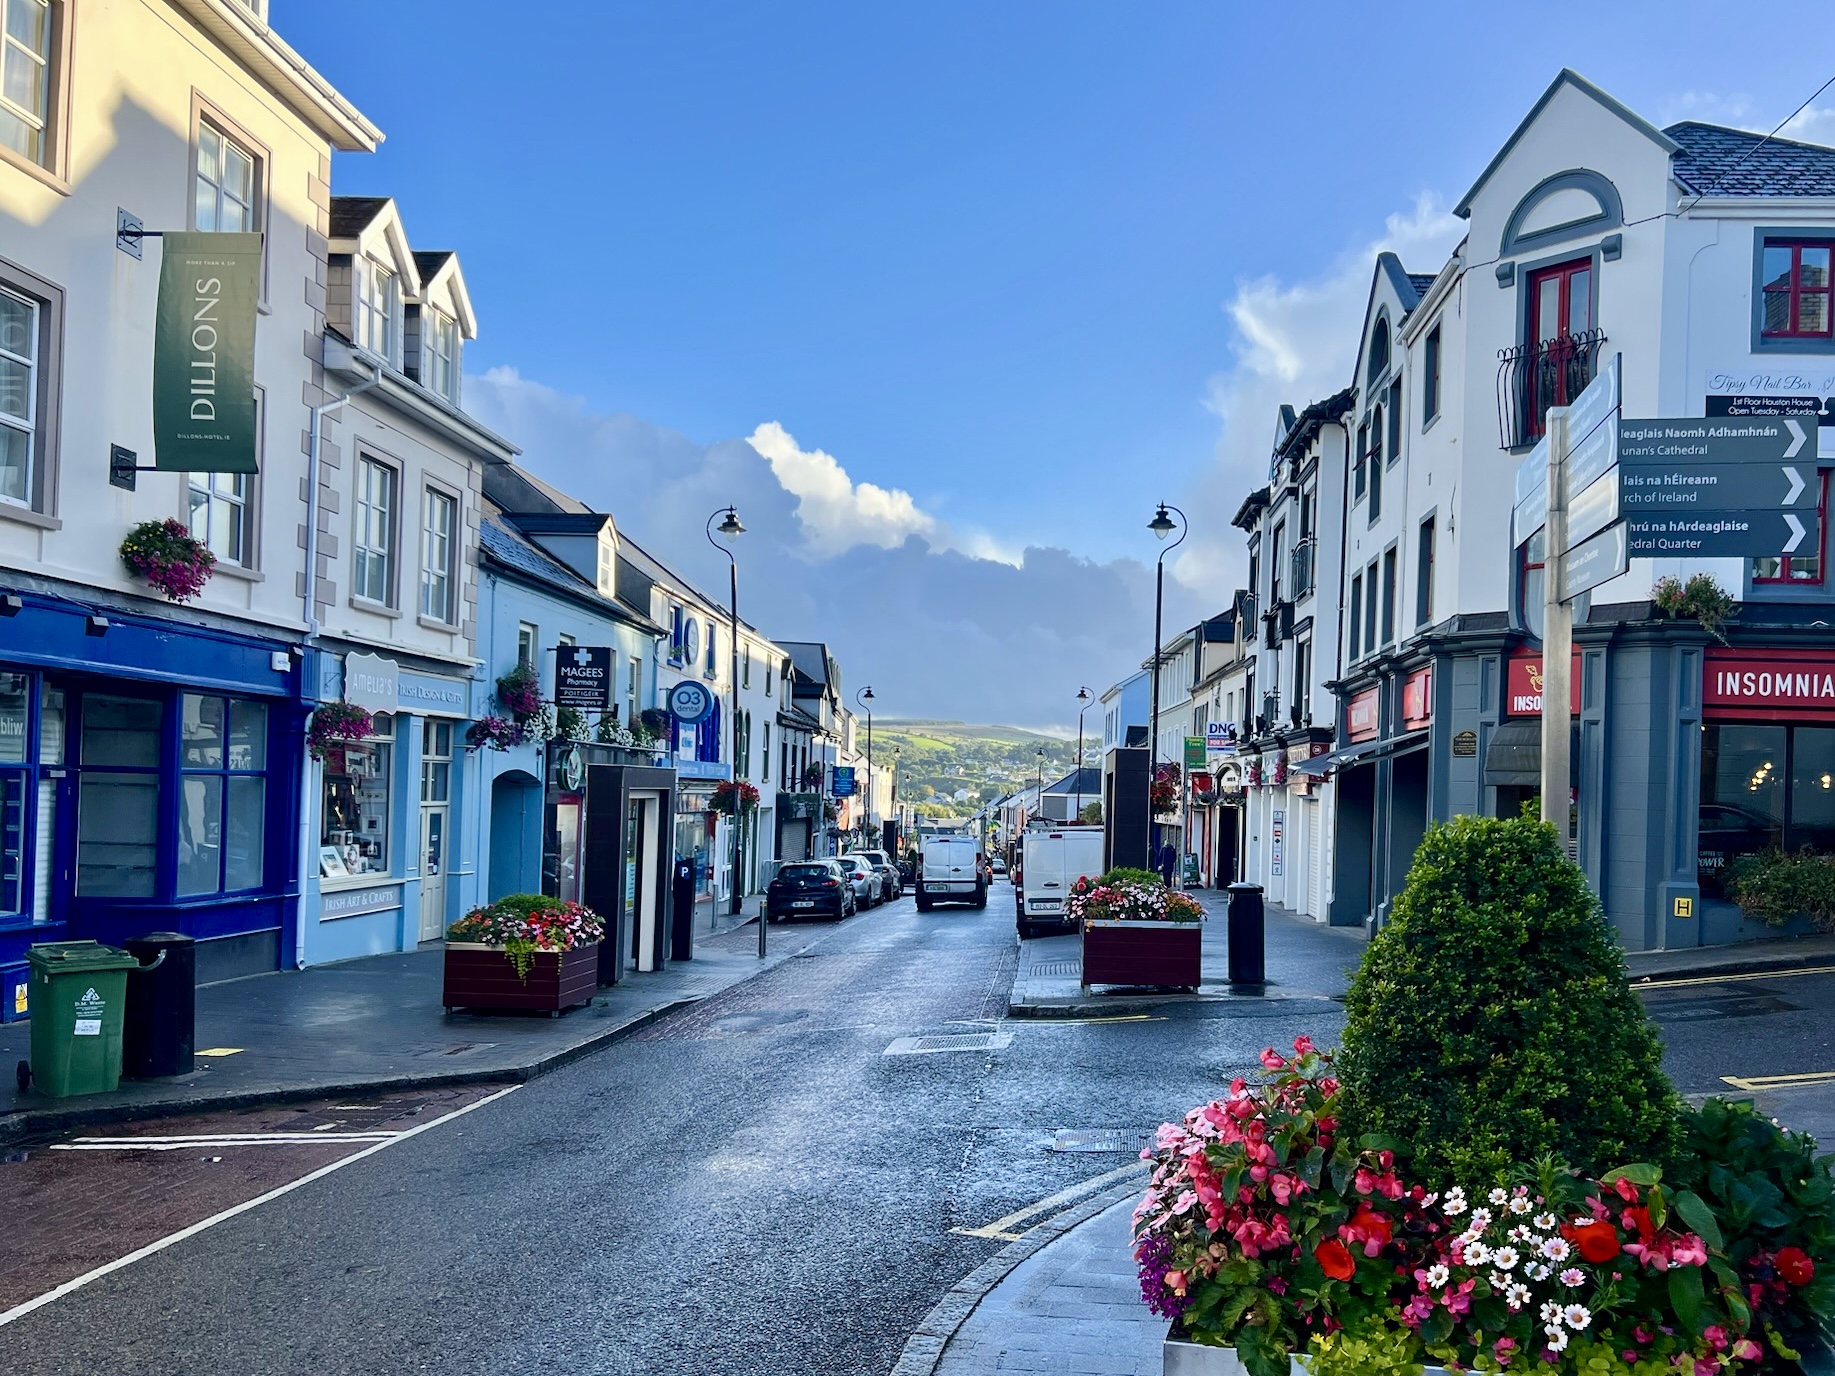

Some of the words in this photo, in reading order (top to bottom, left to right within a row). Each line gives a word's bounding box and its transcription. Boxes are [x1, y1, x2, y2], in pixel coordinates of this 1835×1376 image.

[190, 277, 221, 421] DILLONS
[1708, 374, 1747, 394] Tipsy
[1749, 374, 1782, 391] Nail
[1783, 375, 1812, 390] Bar
[1733, 397, 1743, 406] 1st
[1744, 397, 1761, 406] Floor
[1762, 398, 1791, 407] Houston
[1791, 398, 1814, 407] House
[1728, 406, 1750, 416] Open
[1751, 407, 1779, 416] Tuesday
[1786, 407, 1817, 417] Saturday
[1665, 428, 1706, 438] Naomh
[1708, 426, 1778, 437] Adhamhnán
[1622, 446, 1655, 456] unan's
[1656, 444, 1708, 456] Cathedral
[1623, 475, 1644, 486] lais
[1646, 477, 1661, 486] na
[1664, 473, 1718, 485] hÉireann
[1624, 492, 1642, 503] rch
[1644, 492, 1657, 502] of
[1658, 491, 1697, 502] Ireland
[1629, 521, 1649, 532] hrú
[1652, 523, 1666, 532] na
[1669, 520, 1749, 534] hArdeaglaise
[1629, 538, 1656, 549] edral
[1657, 538, 1702, 549] Quarter
[560, 666, 604, 678] MAGEES
[566, 677, 599, 688] Pharmacy
[1717, 671, 1835, 698] INSOMNIA
[1698, 856, 1725, 868] OWER
[681, 866, 689, 877] P
[325, 898, 346, 911] IRISH
[346, 895, 361, 908] ART
[361, 893, 368, 906] &
[368, 890, 394, 905] CRAFTS
[1677, 899, 1690, 915] H
